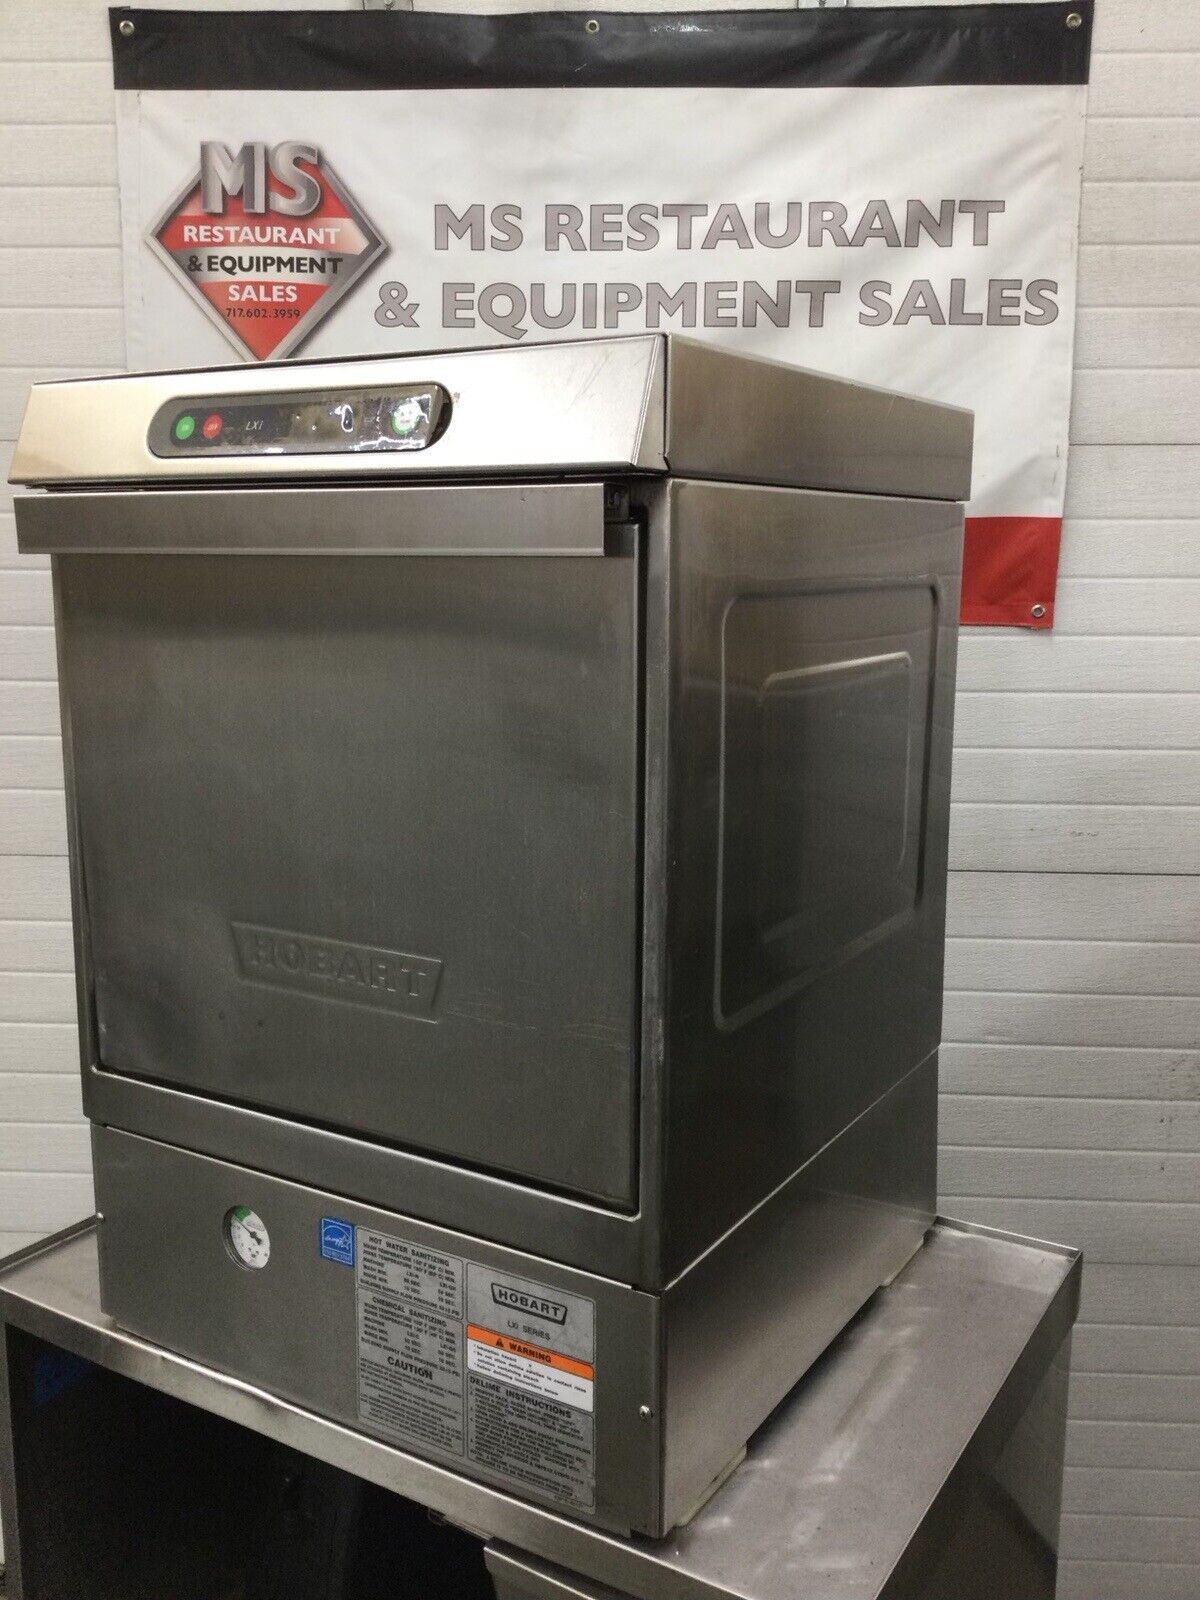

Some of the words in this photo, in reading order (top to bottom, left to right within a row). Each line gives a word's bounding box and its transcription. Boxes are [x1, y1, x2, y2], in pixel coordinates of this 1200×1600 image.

[200, 140, 321, 216] MS
[183, 225, 341, 245] RESTAURANT
[434, 203, 524, 251] MS
[545, 200, 1005, 251] RESTAURANT
[187, 255, 203, 272] &
[207, 255, 343, 274] EQUIPMENT
[228, 285, 298, 302] SALES
[225, 307, 300, 319] 717.602.3959
[374, 281, 420, 328] &
[442, 280, 841, 340] EQUIPMENT
[858, 278, 1059, 327] SALES
[252, 934, 428, 997] HOBART
[368, 1236, 382, 1245] HOT
[385, 1241, 408, 1253] WATER
[411, 1249, 450, 1267] SANITIZING
[372, 1297, 406, 1314] CHEMICAL
[409, 1308, 447, 1328] SANITIZING
[498, 1289, 561, 1317] HOBART
[522, 1325, 551, 1341] SERIES
[508, 1342, 552, 1364] WARNING
[387, 1356, 433, 1380] CAUTION
[469, 1376, 501, 1393] DELIME
[505, 1390, 572, 1419] INSTRUCTIONS
